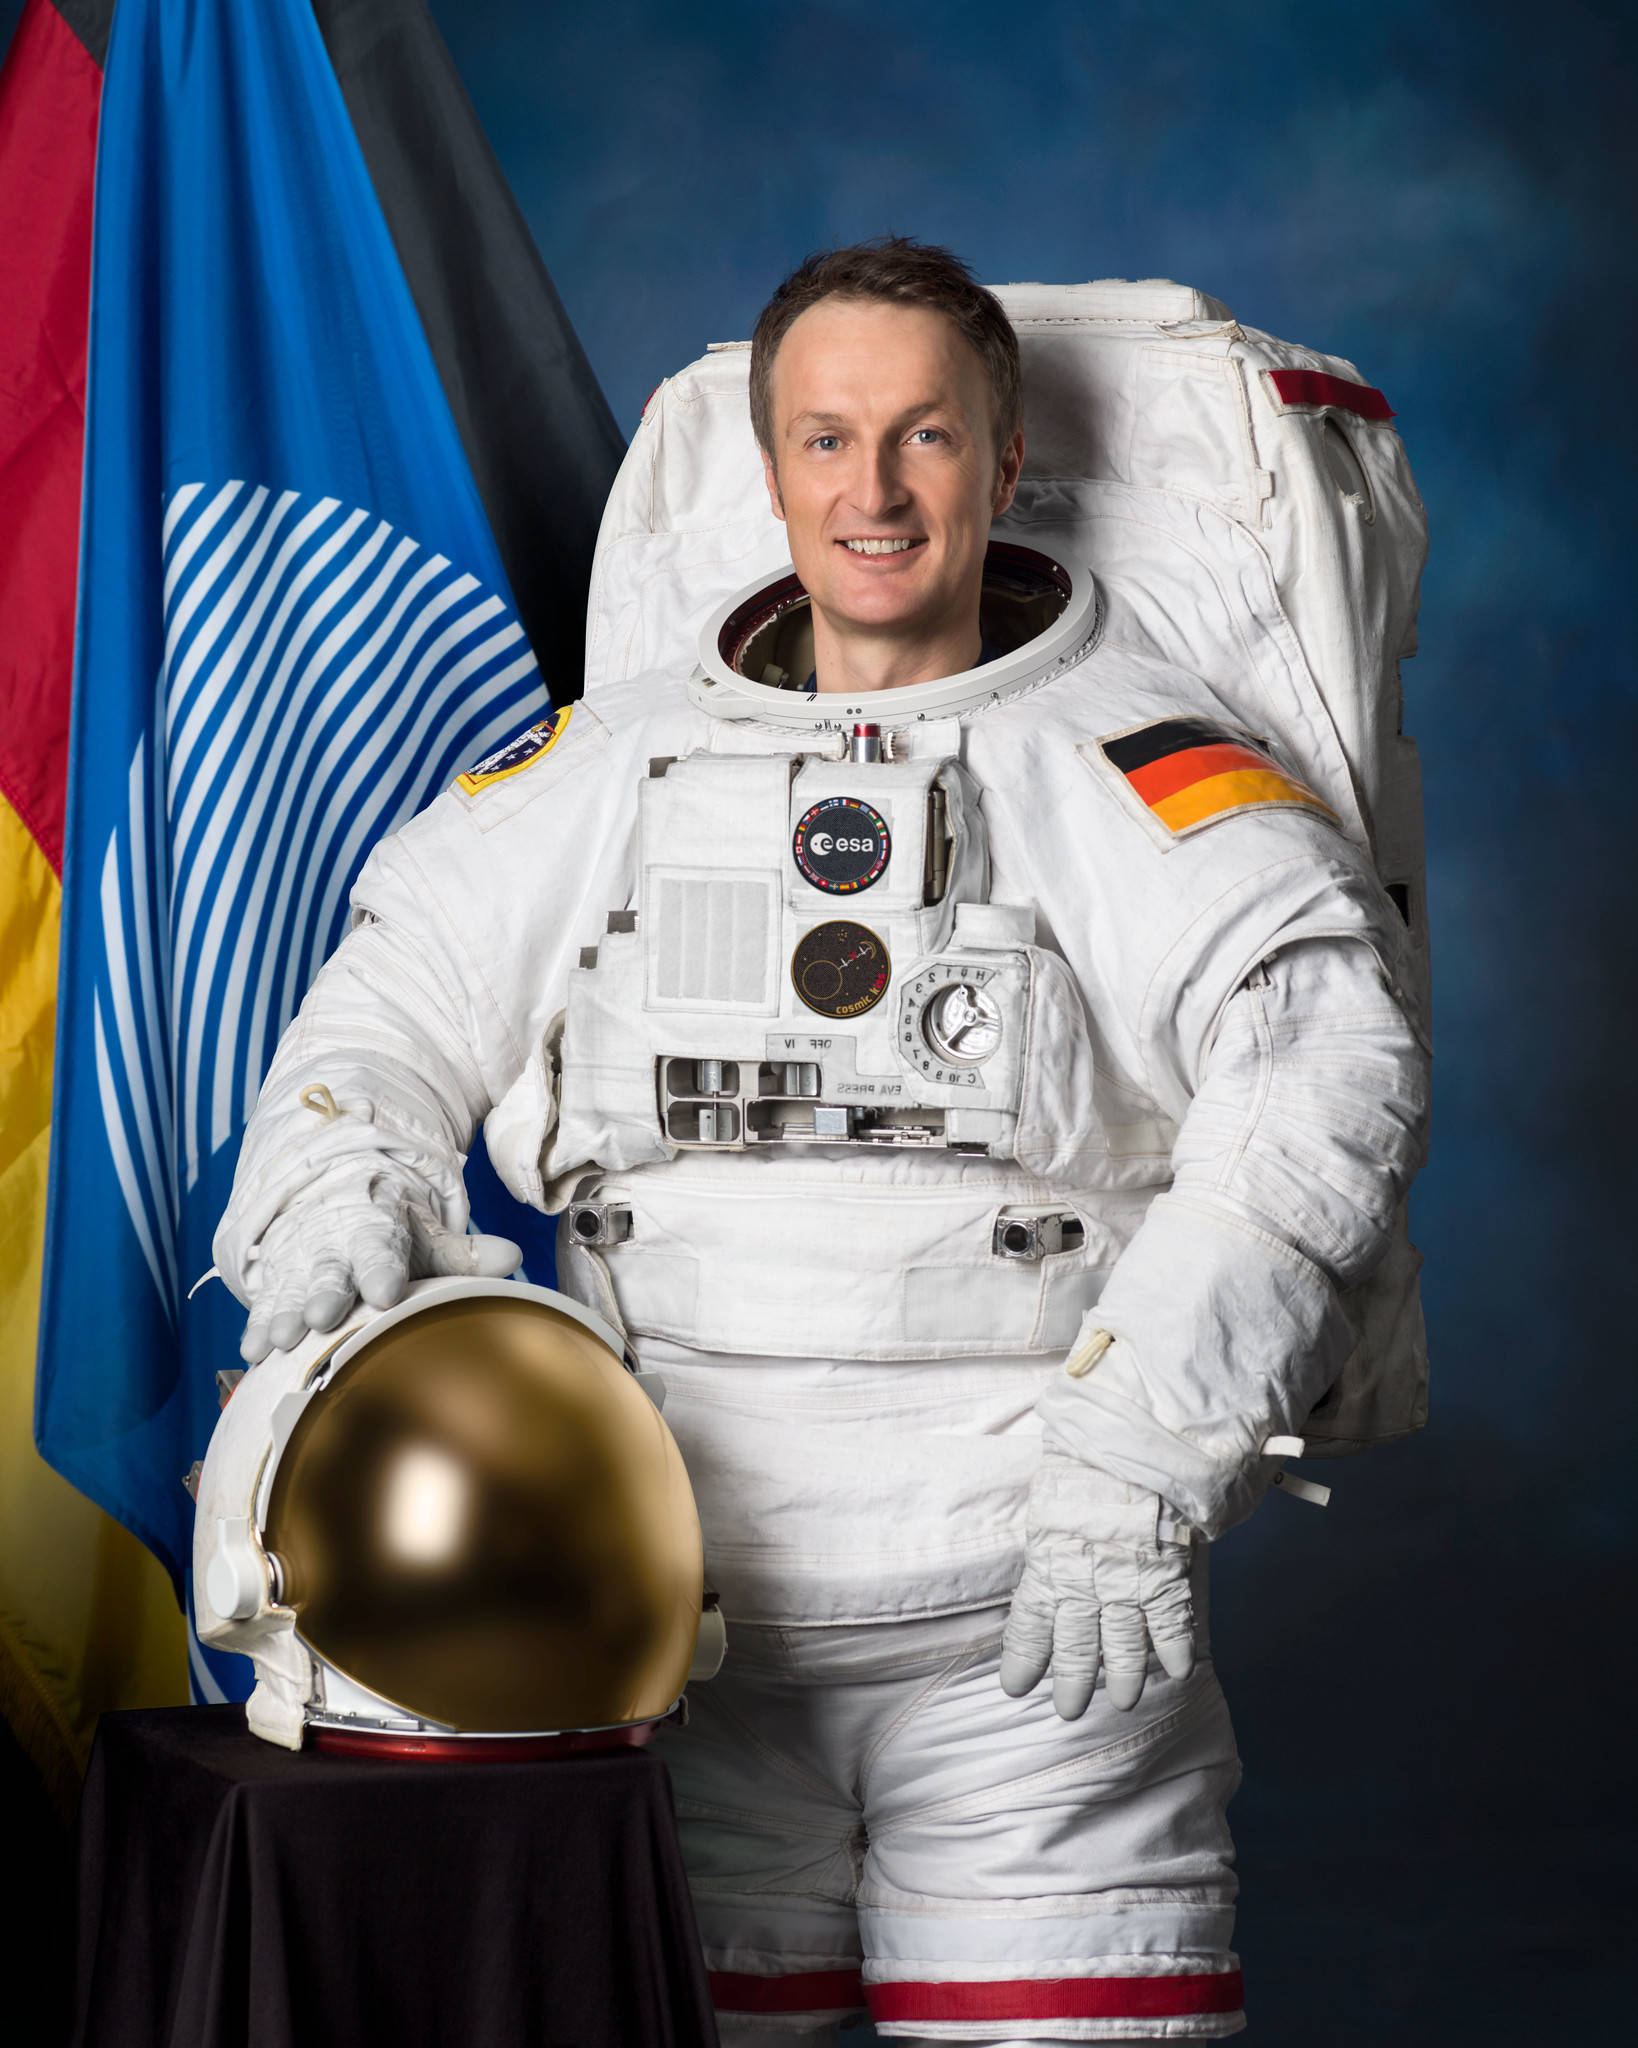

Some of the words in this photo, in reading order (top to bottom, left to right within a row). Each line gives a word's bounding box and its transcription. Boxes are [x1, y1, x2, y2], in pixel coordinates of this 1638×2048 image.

[835, 837, 874, 853] esa
[836, 994, 873, 1014] cosmic
[868, 973, 887, 996] kiss
